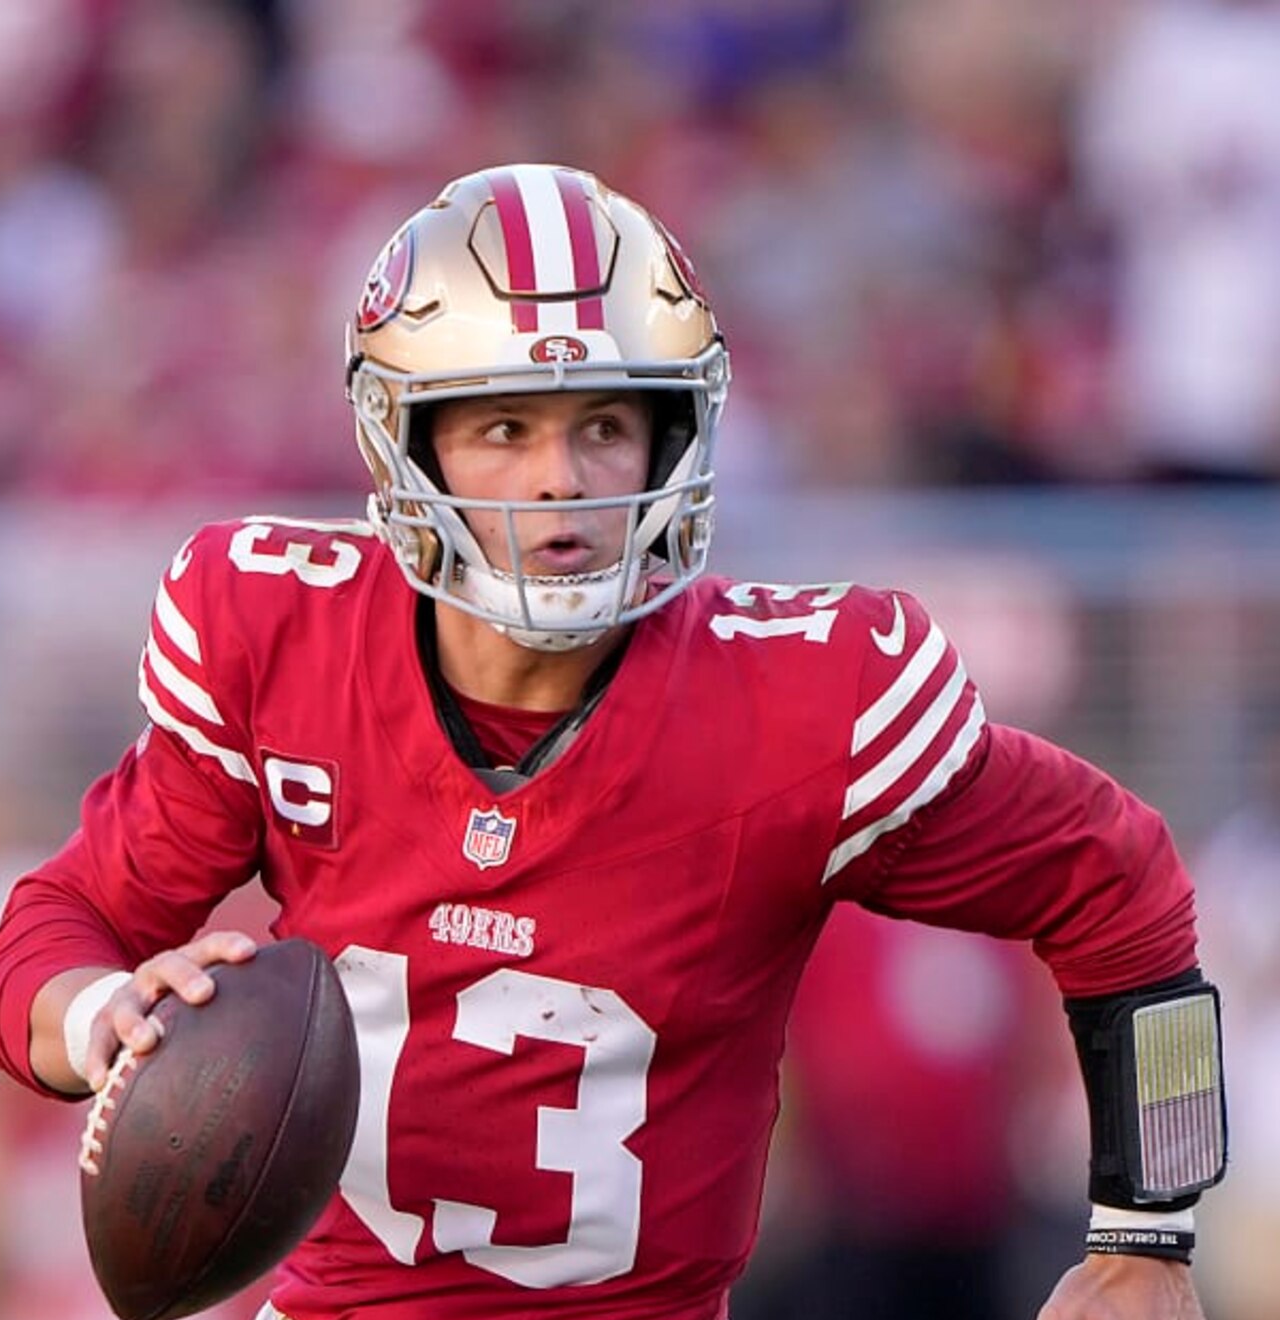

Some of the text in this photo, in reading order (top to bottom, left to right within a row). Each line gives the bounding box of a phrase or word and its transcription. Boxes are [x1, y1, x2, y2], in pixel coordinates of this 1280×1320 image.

[264, 757, 331, 826] C
[471, 832, 502, 857] NFL
[428, 902, 536, 958] 49ERS
[332, 944, 657, 1290] 13
[1119, 1231, 1158, 1244] GREAT
[1160, 1233, 1178, 1245] THE
